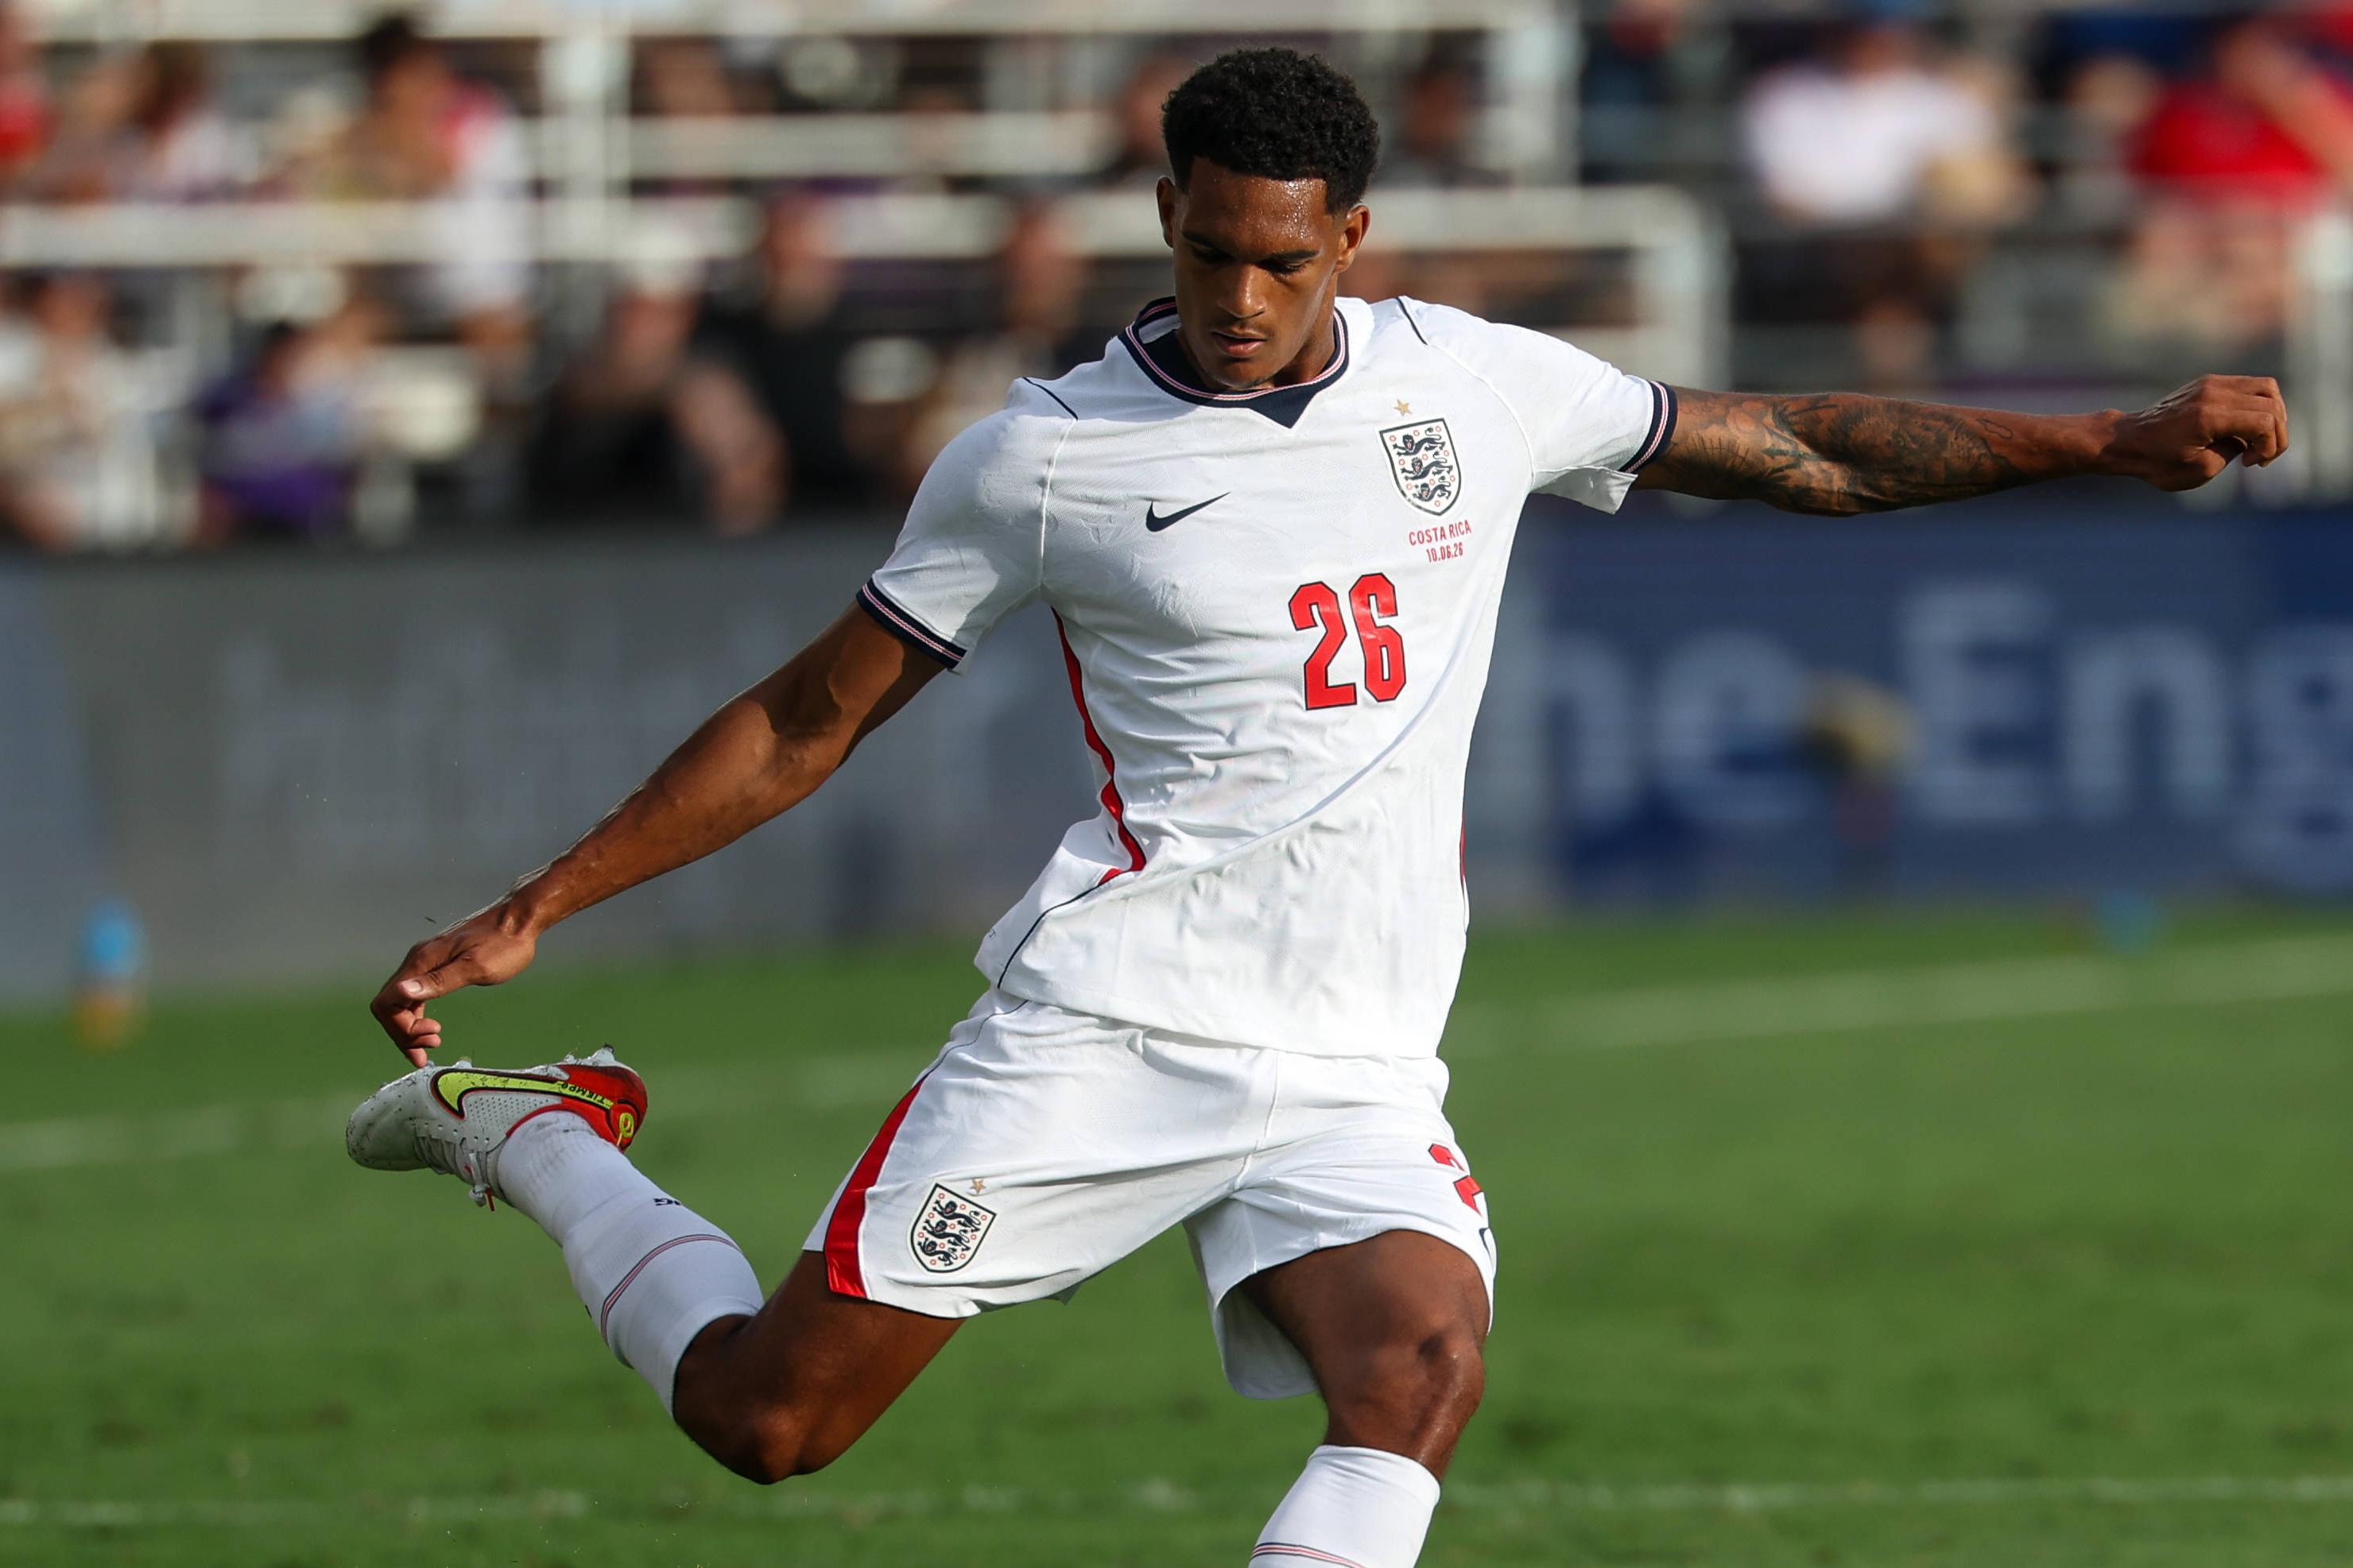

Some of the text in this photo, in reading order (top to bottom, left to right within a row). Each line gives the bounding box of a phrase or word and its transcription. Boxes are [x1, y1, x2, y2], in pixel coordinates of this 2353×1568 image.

[1409, 519, 1472, 546] COSTA RICA
[1426, 541, 1463, 563] 10.06.26
[1288, 572, 1406, 711] 26
[561, 1082, 608, 1105] TIEMPO
